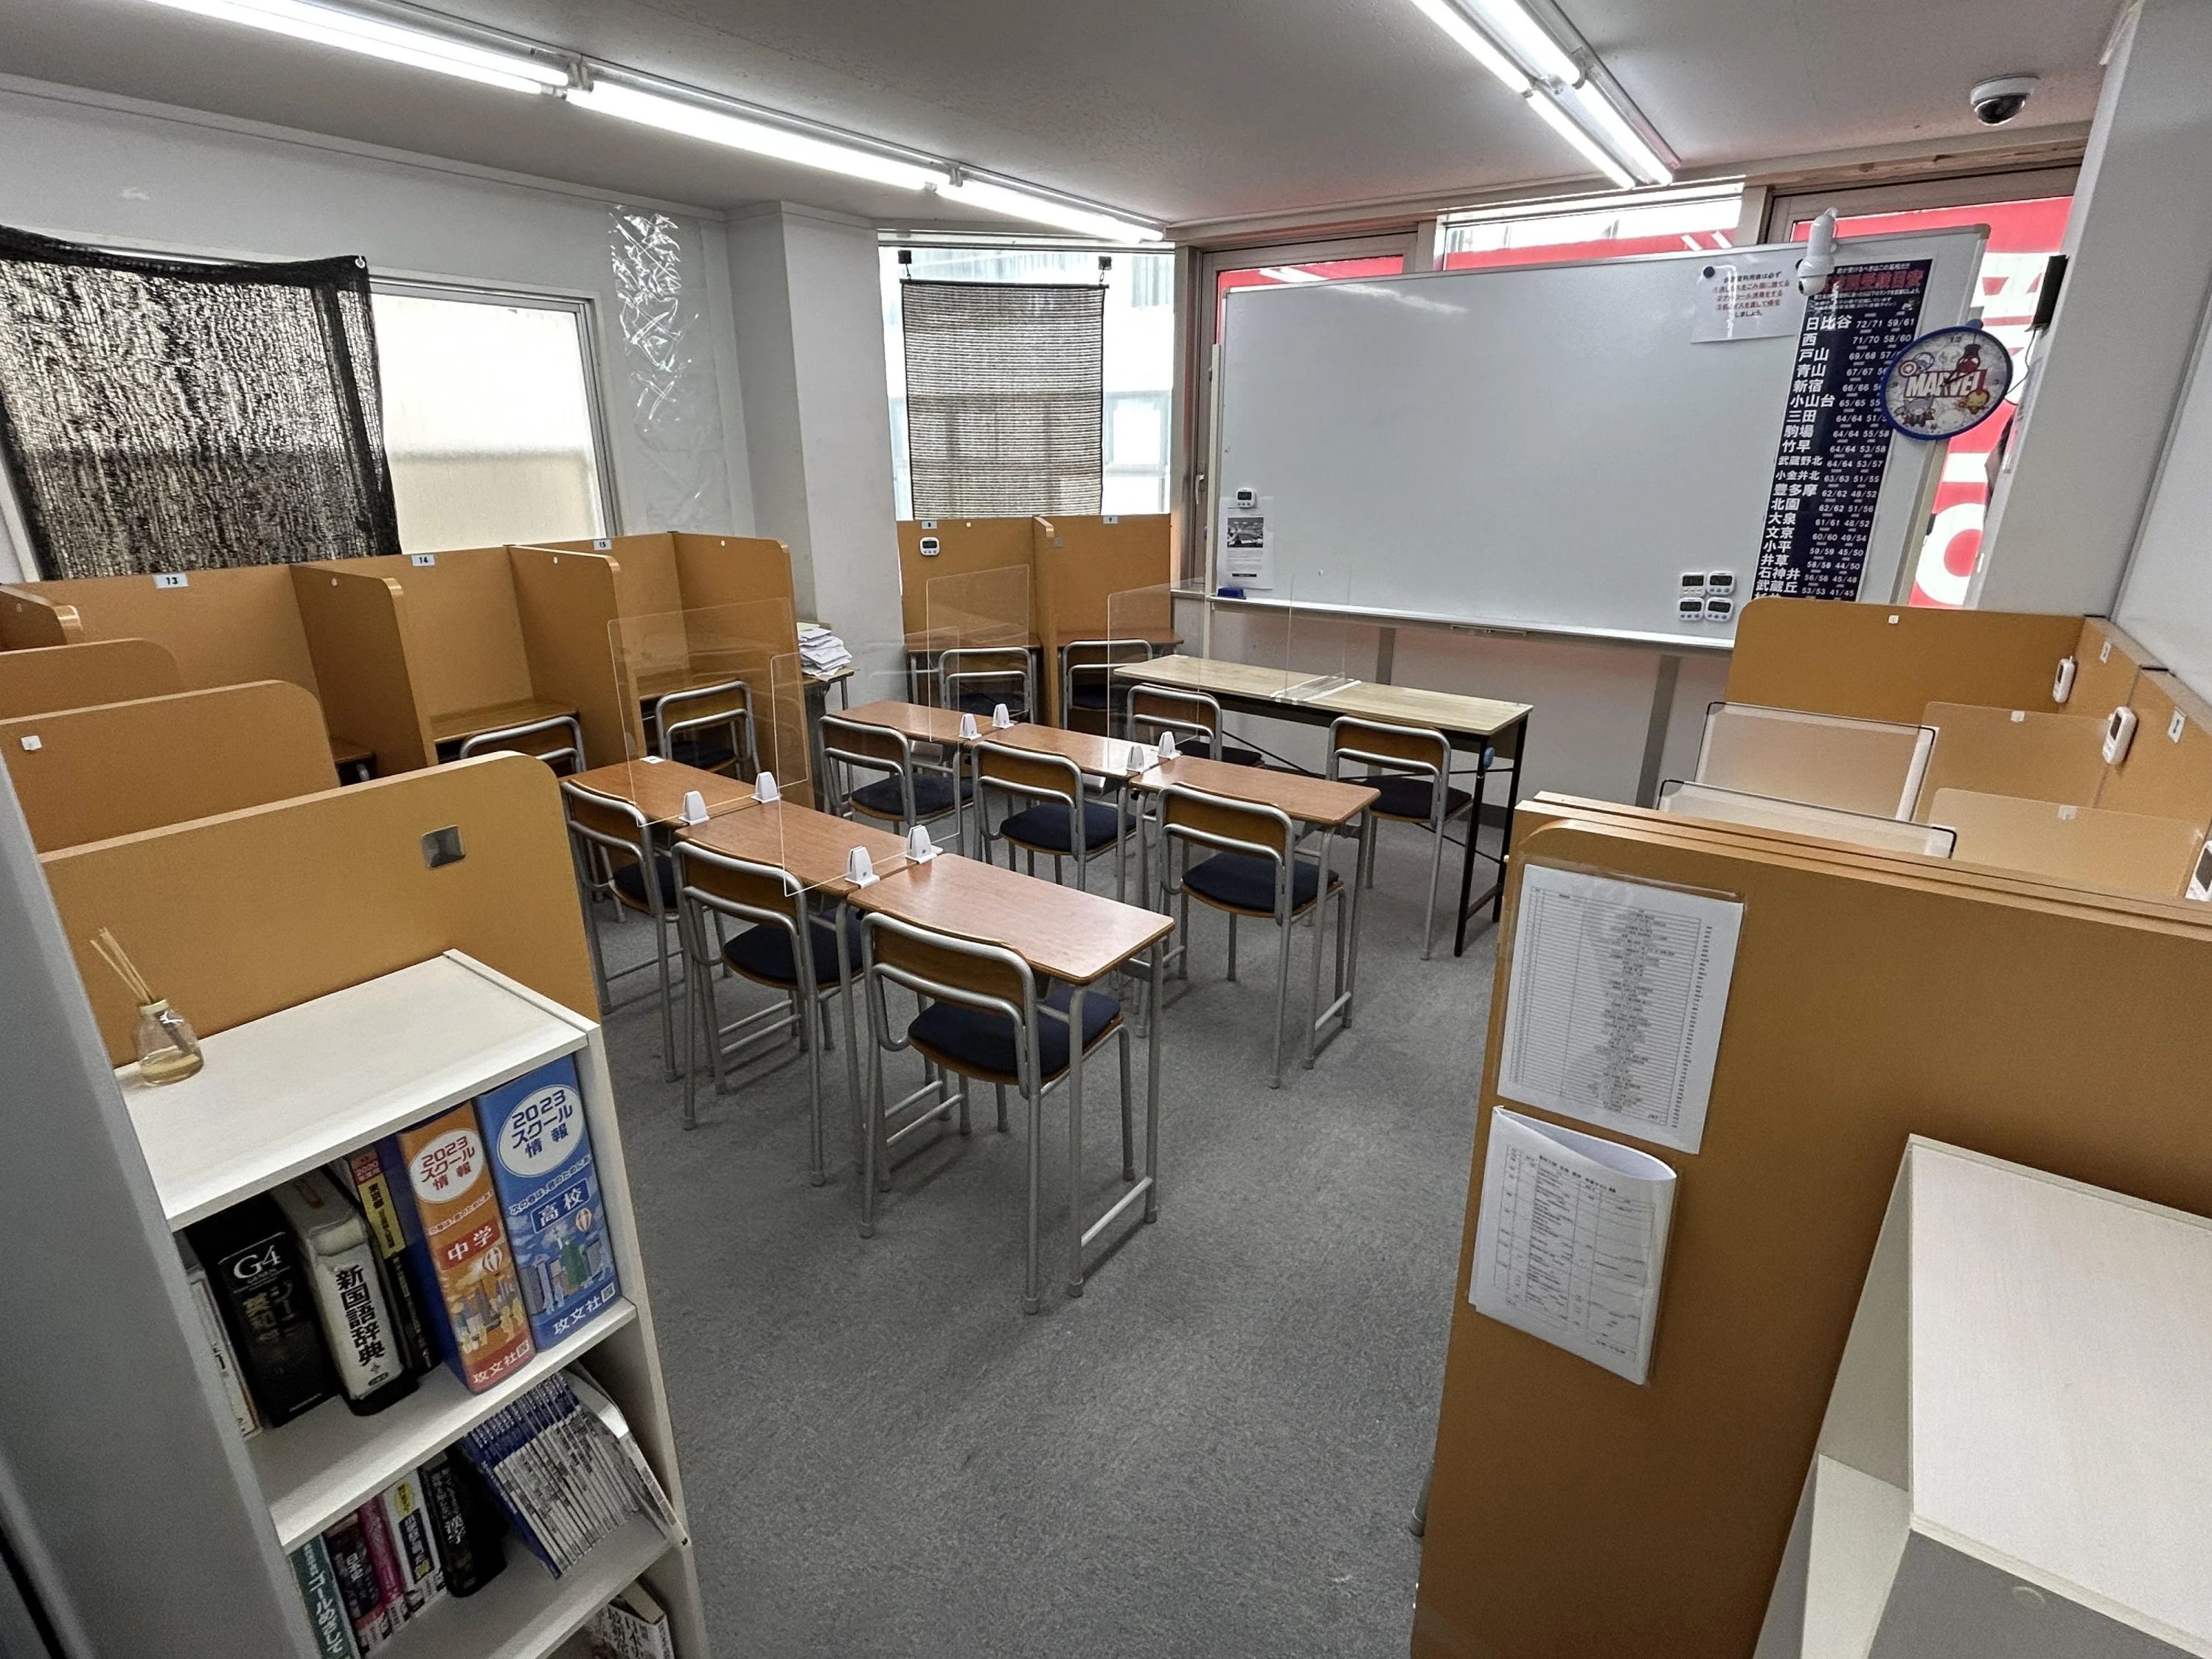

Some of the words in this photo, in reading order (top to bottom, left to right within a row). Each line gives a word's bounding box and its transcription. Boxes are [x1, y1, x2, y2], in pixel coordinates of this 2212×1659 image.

[1806, 316, 1851, 331] 日比谷
[1802, 333, 1818, 347] 西
[1799, 347, 1829, 361] 戸山
[1797, 364, 1826, 377] 青山
[1793, 380, 1823, 392] 新宿
[1790, 394, 1835, 408] 小山台
[1787, 410, 1817, 422] 三田
[1784, 425, 1815, 438] 駒場
[1782, 440, 1811, 453] 竹早
[1778, 456, 1823, 466] 武蔵野北
[1776, 470, 1820, 480] 小金井北
[1773, 484, 1818, 496] 豊多摩
[1771, 498, 1800, 510] 北園
[1768, 512, 1796, 525] 大泉
[1765, 526, 1795, 539] 文京
[1763, 540, 1792, 553] 小平
[1761, 554, 1790, 566] 井草
[1759, 567, 1801, 580] 石神井
[1756, 580, 1798, 594] 武蔵丘
[511, 1089, 567, 1130] 2023
[511, 1105, 574, 1150] スクール
[524, 1123, 569, 1158] 情報
[421, 1135, 469, 1168] 2023
[420, 1146, 476, 1183] スクール
[433, 1162, 472, 1190] 情報
[538, 1187, 585, 1228] 高校
[448, 1225, 493, 1261] 中学
[234, 1245, 283, 1279] G4
[335, 1264, 386, 1367] 新国語辞典
[553, 1295, 602, 1335] 攻文社
